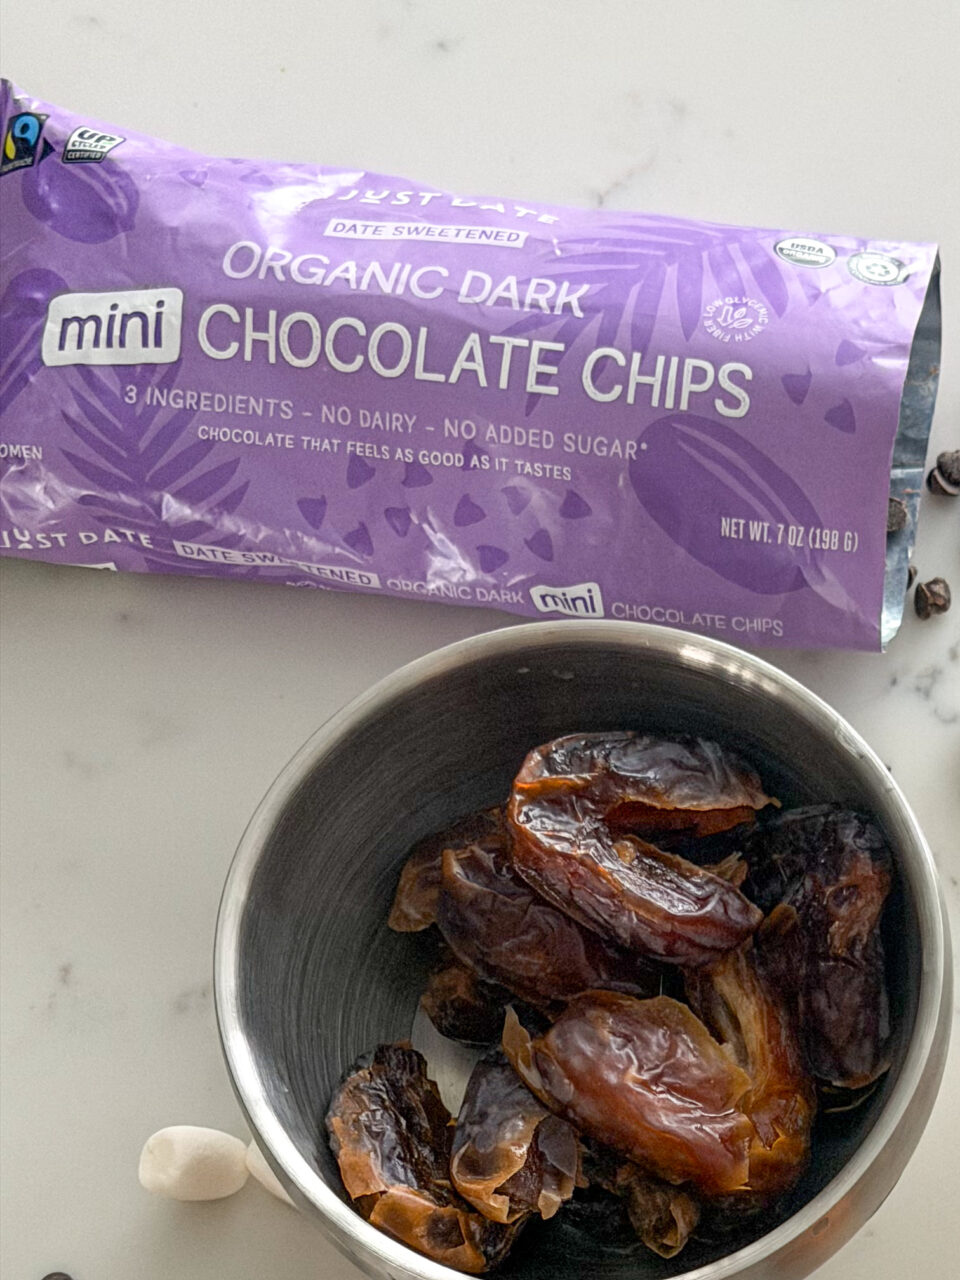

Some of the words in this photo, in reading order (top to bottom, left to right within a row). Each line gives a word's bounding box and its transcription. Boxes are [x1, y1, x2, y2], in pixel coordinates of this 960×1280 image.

[78, 129, 116, 143] UP
[337, 189, 442, 206] JUST
[332, 222, 388, 236] DATE
[392, 226, 520, 242] SWEETENED
[790, 242, 824, 254] USDA
[222, 240, 449, 299] ORGANIC
[458, 269, 590, 318] DARK
[703, 299, 723, 317] LOW
[58, 300, 165, 351] mini
[199, 303, 565, 395] CHOCOLATE
[582, 347, 753, 418] CHIPS
[125, 385, 137, 404] 3
[146, 386, 294, 420] INGREDIENTS
[321, 405, 351, 427] NO
[359, 409, 417, 434] DAIRY
[443, 418, 476, 440] NO
[485, 423, 555, 450] ADDED
[198, 425, 295, 449] CHOCOLATE
[302, 436, 341, 454] THAT
[347, 440, 390, 461] FEELS
[395, 446, 414, 463] AS
[418, 451, 464, 468] GOOD
[470, 453, 490, 471] AS
[495, 457, 509, 472] IT
[514, 460, 572, 482] TASTES
[0, 527, 67, 549] JUST
[79, 528, 153, 548] DATE
[720, 517, 745, 540] NET
[749, 521, 772, 543] WT.
[777, 523, 786, 545] 7
[788, 525, 804, 547] OZ
[808, 527, 841, 551] (198
[844, 531, 859, 552] G)
[181, 544, 233, 562] DATE
[242, 552, 372, 585] SWTENED
[386, 578, 472, 600] ORGANIC
[476, 587, 525, 604] DARK
[539, 588, 596, 614] mini
[611, 602, 726, 630] CHOCOLATE
[731, 616, 784, 637] CHIPS
